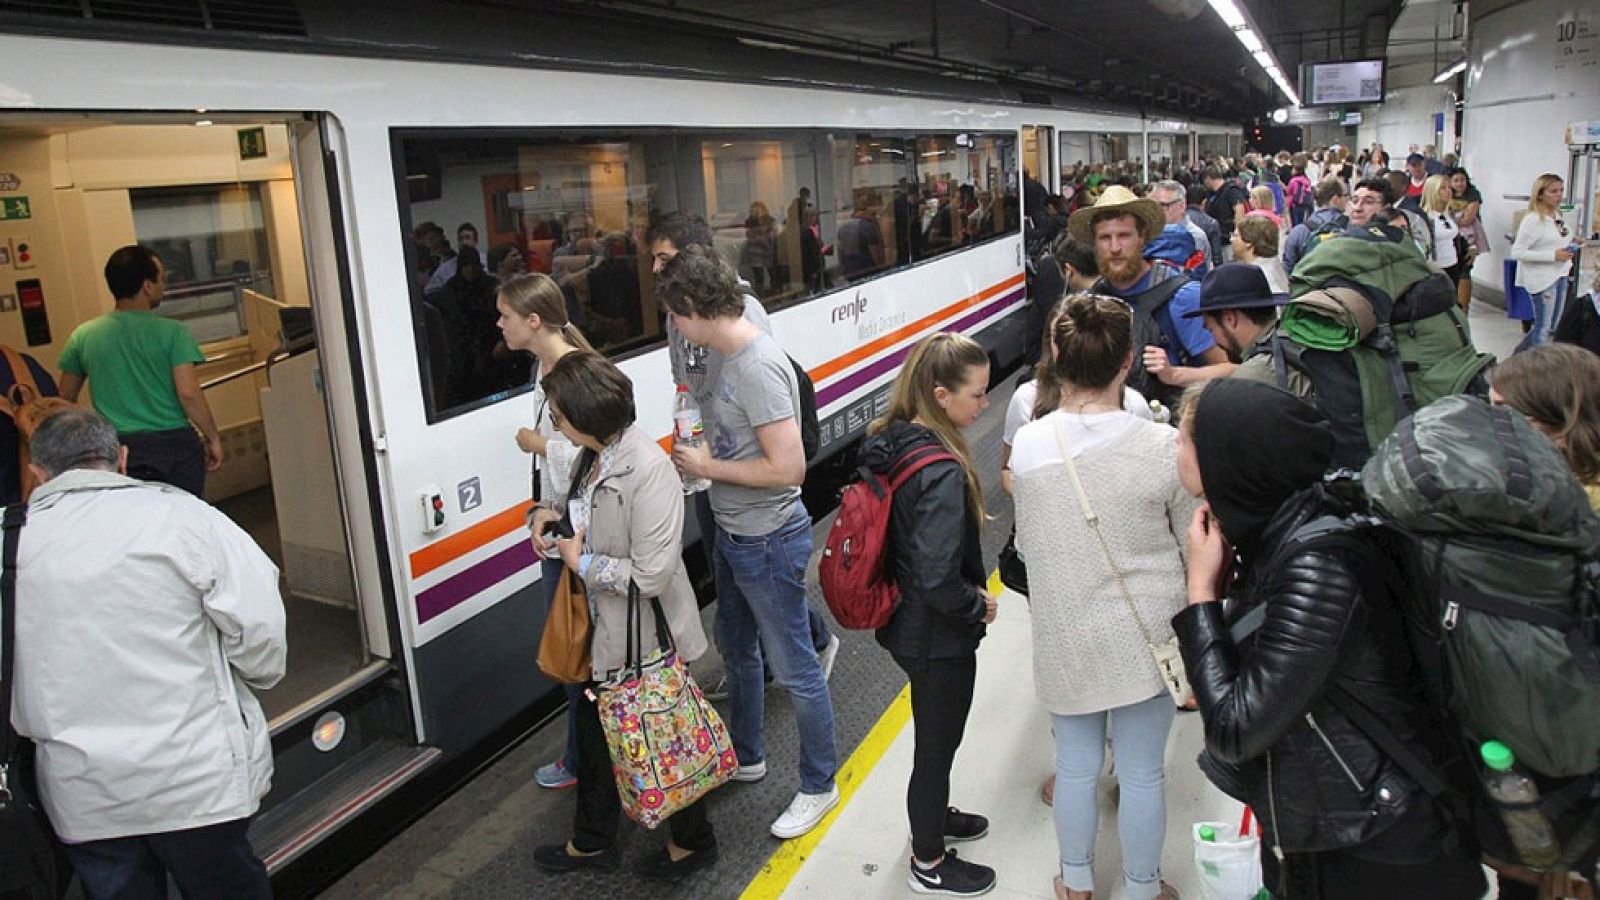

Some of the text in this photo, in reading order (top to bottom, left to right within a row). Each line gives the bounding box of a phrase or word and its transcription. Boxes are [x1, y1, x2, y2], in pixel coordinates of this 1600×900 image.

[1557, 21, 1576, 42] 10
[832, 290, 868, 325] renfe
[463, 487, 476, 509] 2
